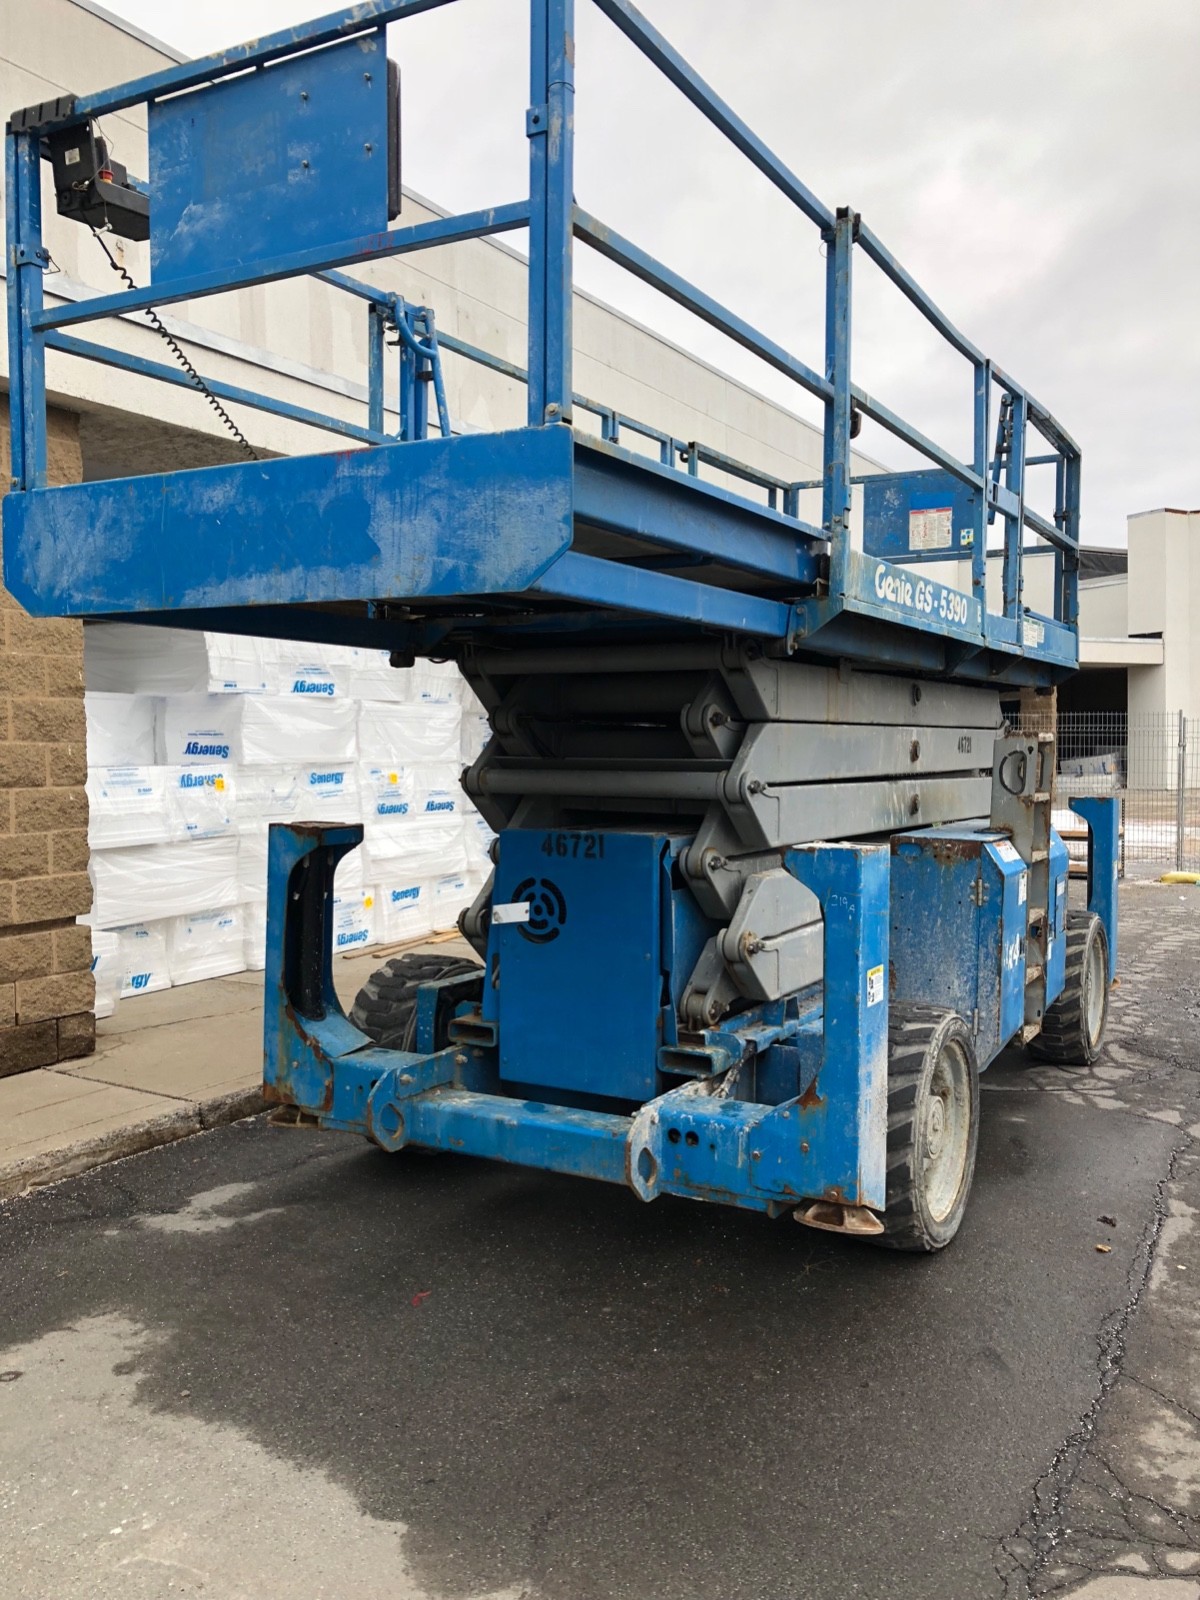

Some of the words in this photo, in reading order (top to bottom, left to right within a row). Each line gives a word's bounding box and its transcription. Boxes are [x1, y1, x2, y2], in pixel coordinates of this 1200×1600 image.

[875, 564, 913, 608] Genie
[292, 680, 335, 696] Senergy
[185, 742, 230, 758] Senergy
[310, 772, 344, 785] Senergy
[424, 801, 455, 812] Senergy
[542, 834, 604, 859] 46721
[392, 886, 421, 903] Senergy
